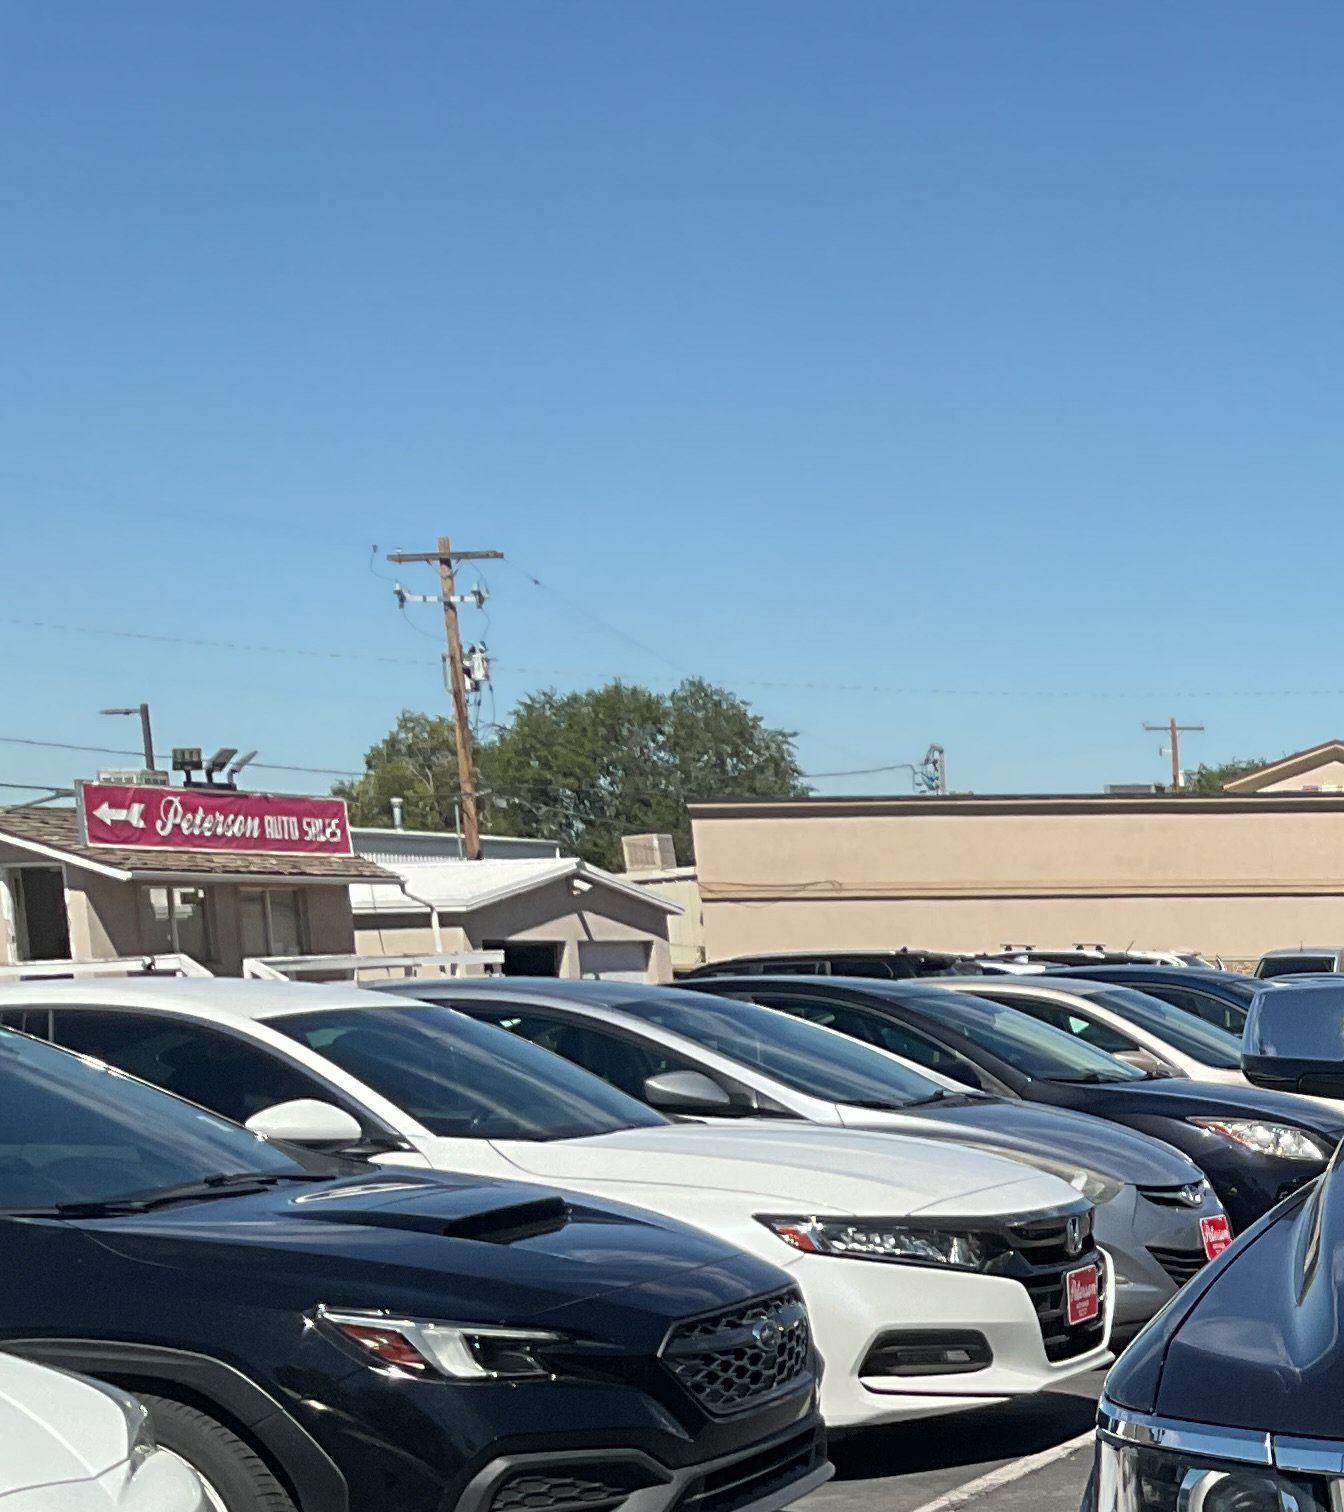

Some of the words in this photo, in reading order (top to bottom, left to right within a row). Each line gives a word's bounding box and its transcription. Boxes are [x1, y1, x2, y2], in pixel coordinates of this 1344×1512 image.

[155, 796, 261, 839] Peterson
[264, 815, 300, 840] AUTO
[302, 817, 341, 843] SALES
